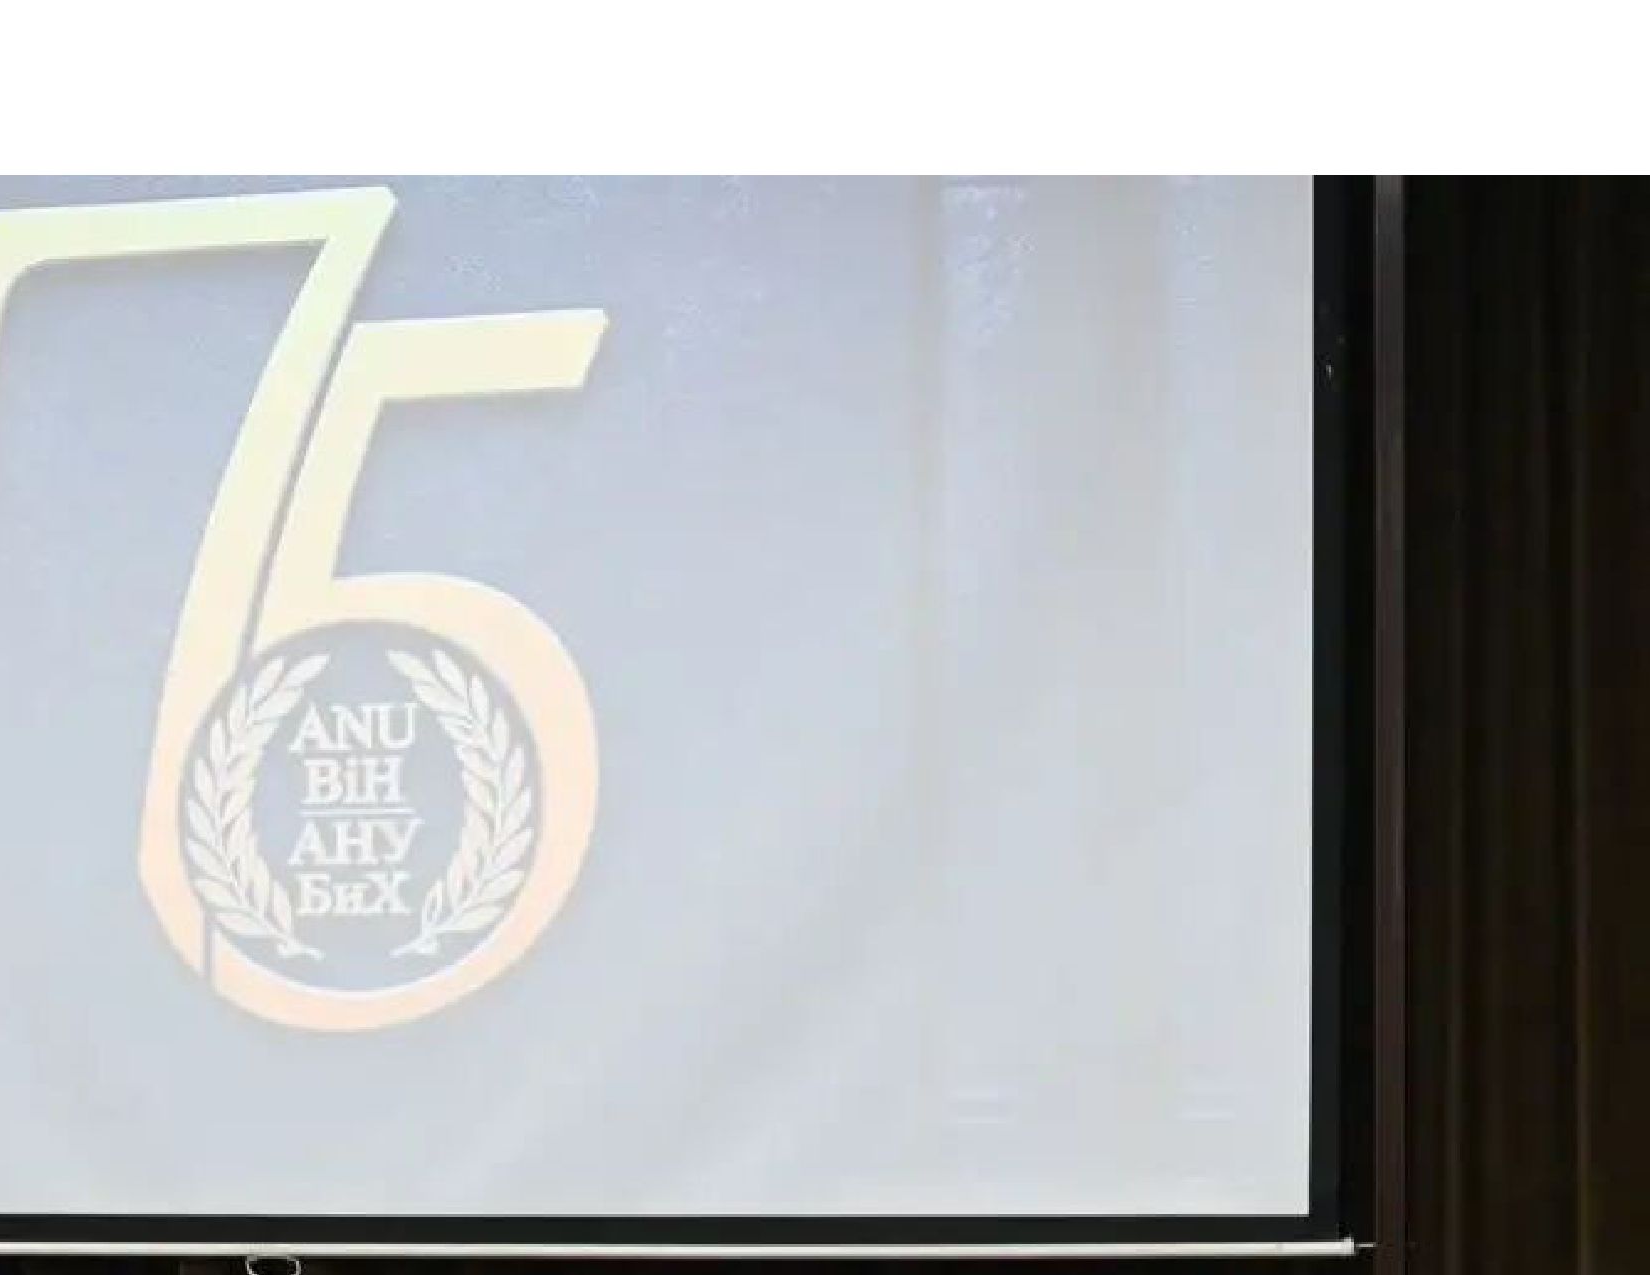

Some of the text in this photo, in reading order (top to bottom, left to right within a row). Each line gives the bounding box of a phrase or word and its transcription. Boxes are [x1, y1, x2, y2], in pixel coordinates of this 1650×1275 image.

[288, 702, 417, 753] ANU
[302, 757, 403, 804] BiH
[287, 818, 425, 866] АНУ
[297, 871, 410, 916] БиХ
